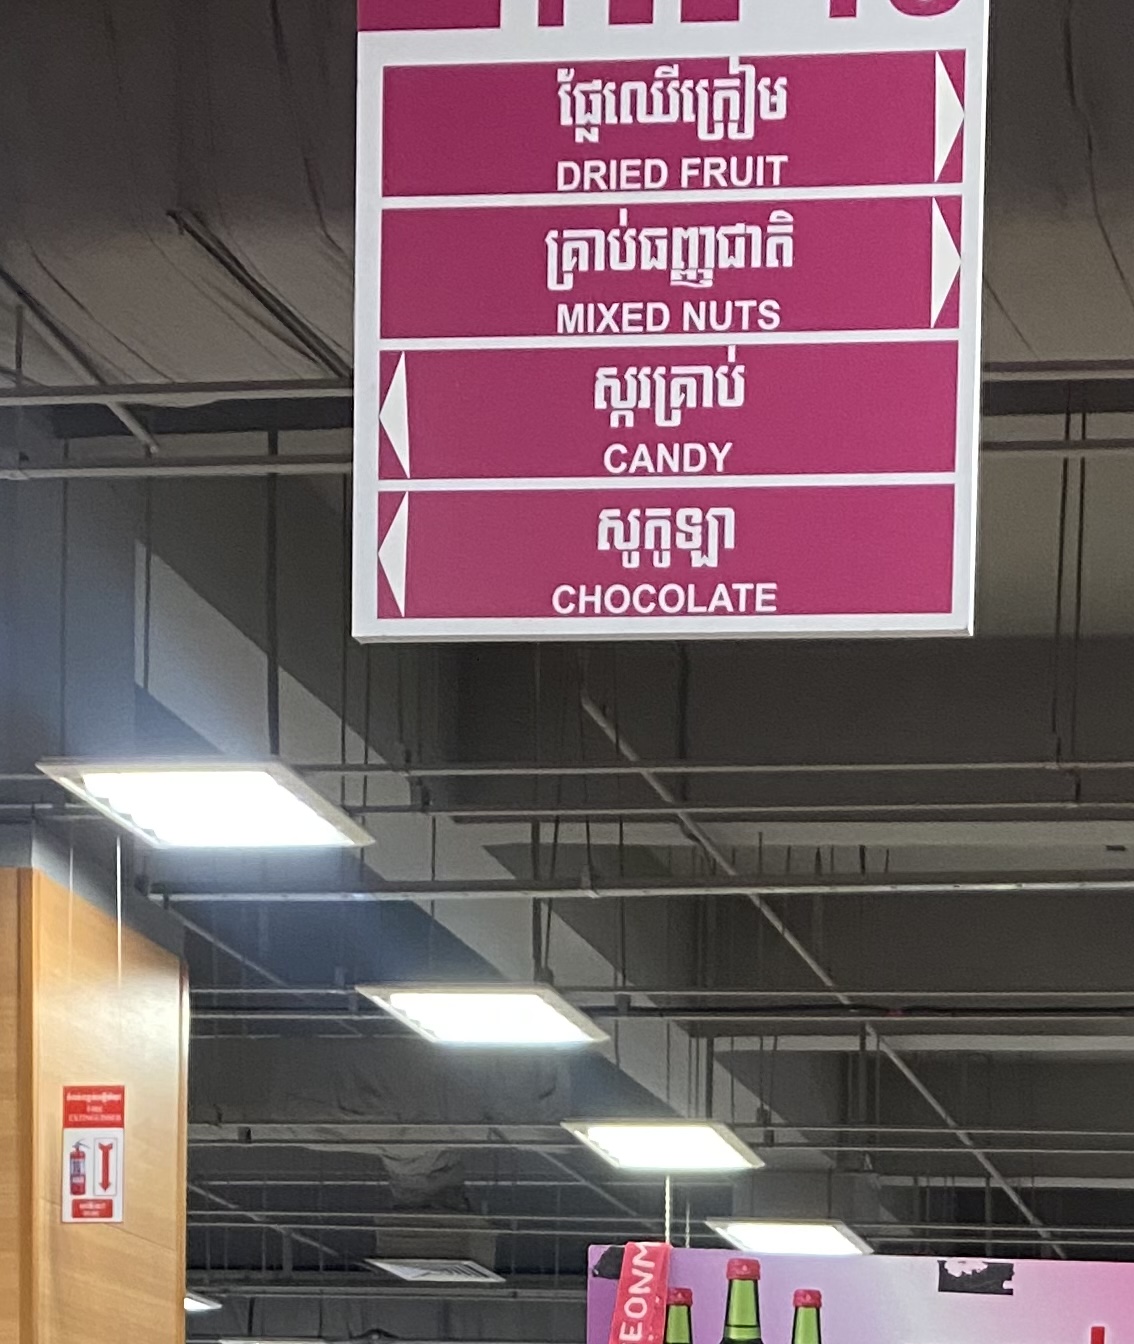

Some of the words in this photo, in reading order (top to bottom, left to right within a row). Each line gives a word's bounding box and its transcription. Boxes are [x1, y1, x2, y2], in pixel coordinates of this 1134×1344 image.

[557, 159, 668, 191] DRIED
[681, 155, 788, 188] FRUIT
[557, 303, 670, 334] MIXED
[682, 299, 781, 331] NUTS
[603, 442, 733, 473] CANDY
[598, 507, 735, 568] សូកូឡា
[551, 581, 778, 614] CHOCOLATE
